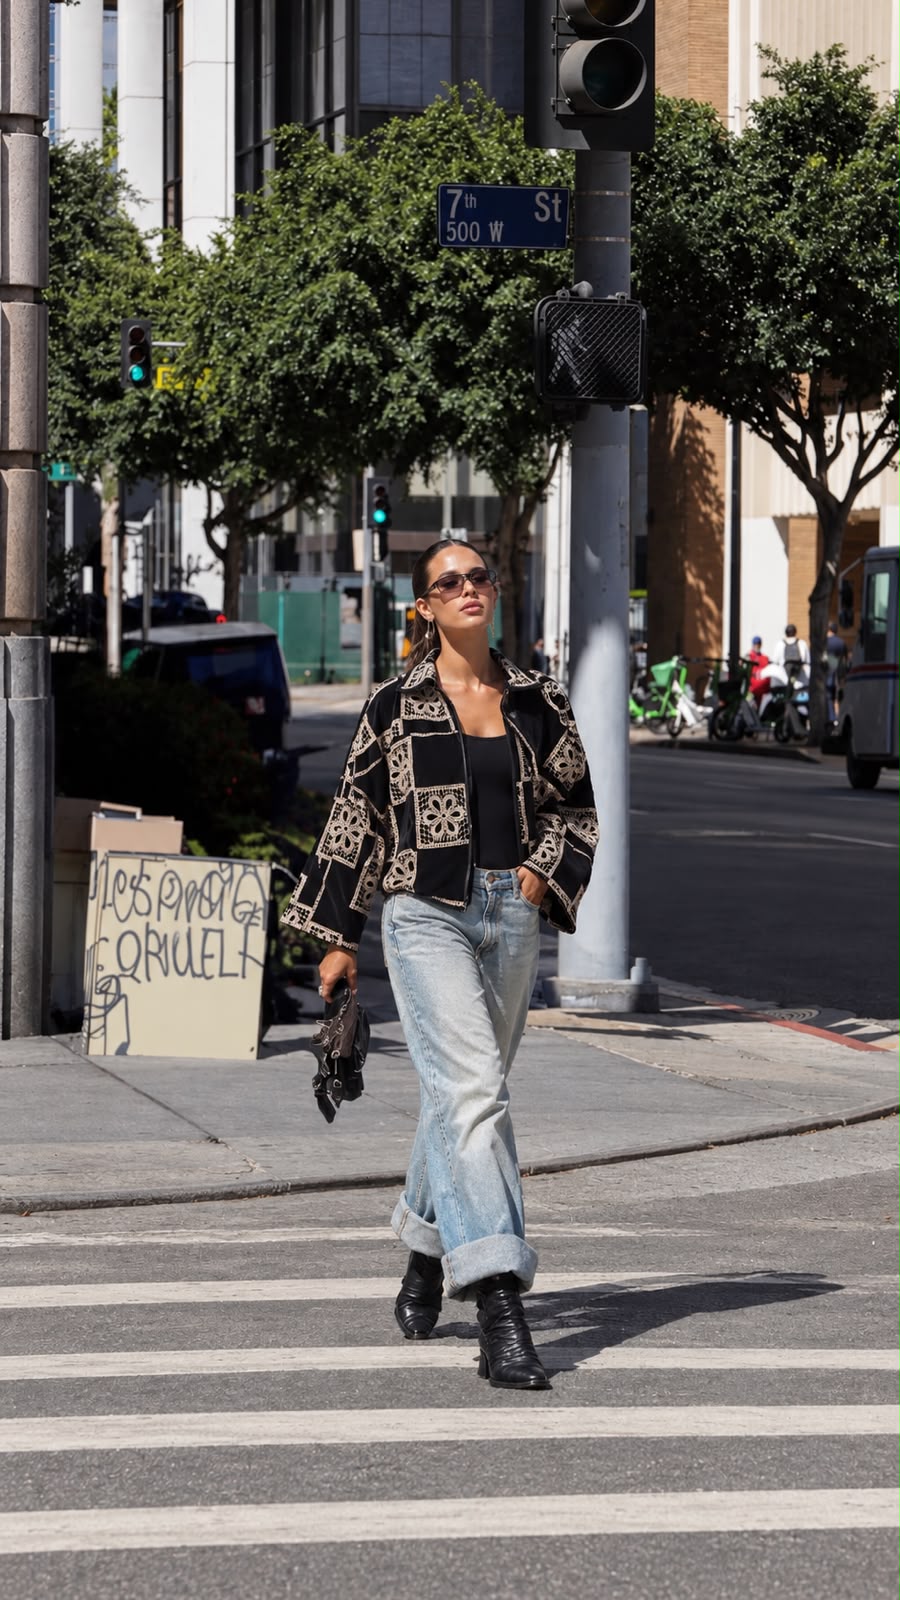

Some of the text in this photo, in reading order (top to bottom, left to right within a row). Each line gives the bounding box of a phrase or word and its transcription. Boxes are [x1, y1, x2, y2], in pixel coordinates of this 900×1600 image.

[446, 189, 562, 222] 7th St
[446, 220, 504, 242] 500 W
